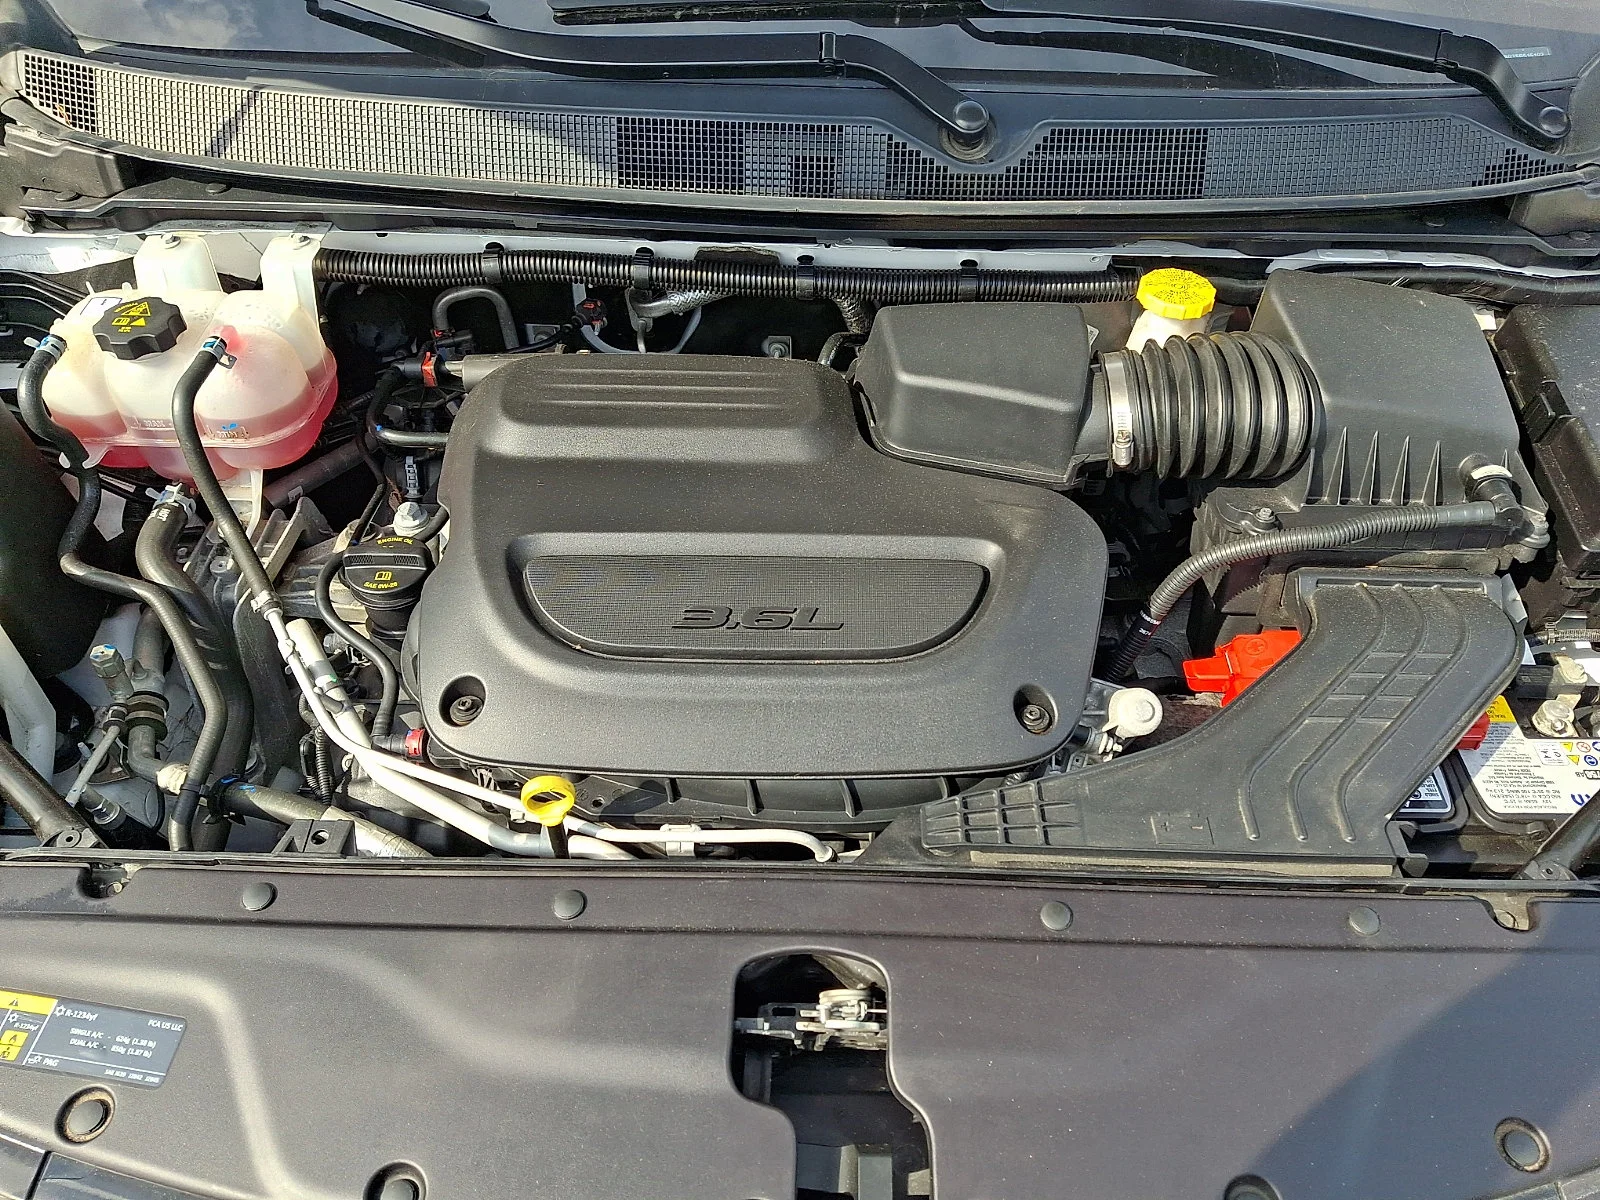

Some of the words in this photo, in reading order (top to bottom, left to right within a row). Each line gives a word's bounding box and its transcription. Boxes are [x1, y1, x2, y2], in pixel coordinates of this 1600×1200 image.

[672, 606, 844, 630] 3.6L
[64, 1009, 98, 1021] R-1234yf
[148, 1019, 161, 1028] FCA
[162, 1022, 171, 1030] US
[171, 1023, 184, 1032] LLC
[70, 1027, 91, 1037] SINGLE
[91, 1030, 104, 1039] A/C
[69, 1038, 86, 1047] DUAL
[86, 1040, 100, 1049] A/C
[42, 1058, 59, 1067] PAG
